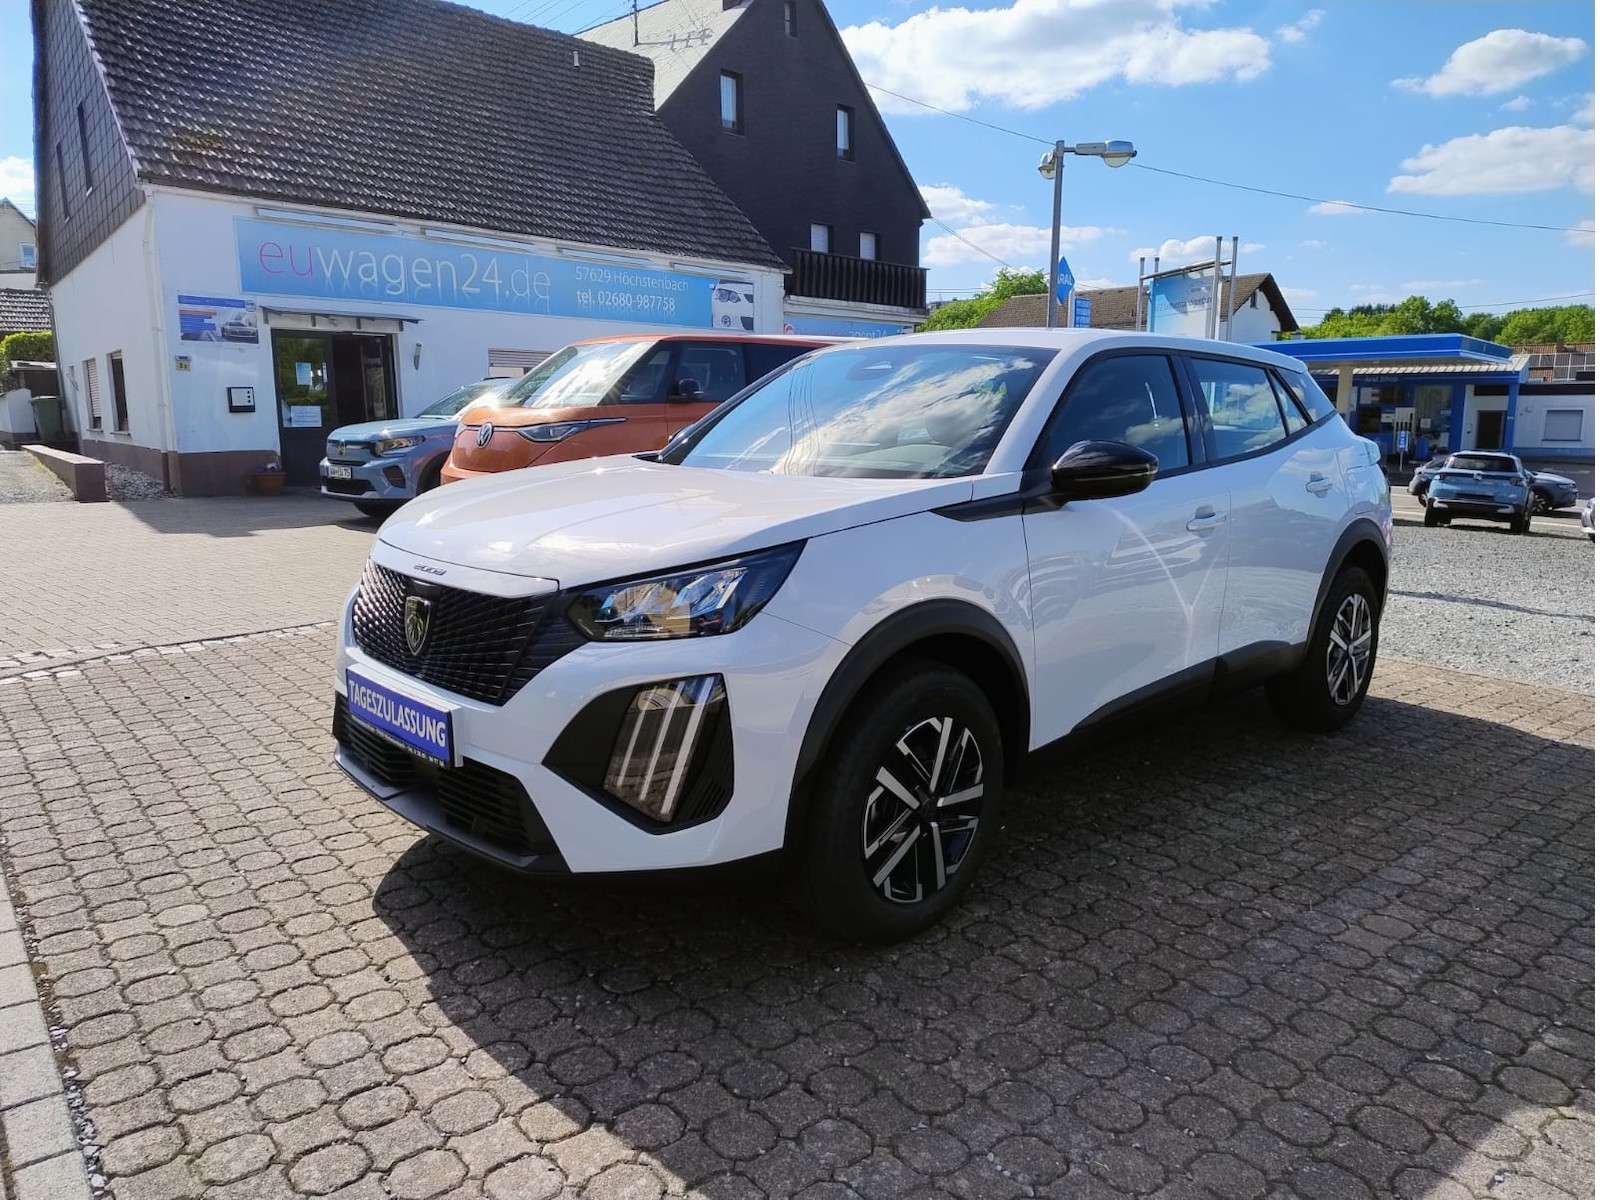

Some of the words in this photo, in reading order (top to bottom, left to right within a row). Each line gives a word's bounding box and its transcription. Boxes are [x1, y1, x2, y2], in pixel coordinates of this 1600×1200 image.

[258, 241, 551, 298] euwagen24.de
[575, 265, 611, 283] 57629
[614, 271, 689, 292] Höchstenbach
[576, 289, 595, 304] tel.
[598, 291, 676, 311] 02680-987758
[347, 680, 447, 748] TAGESZULASSUNG
